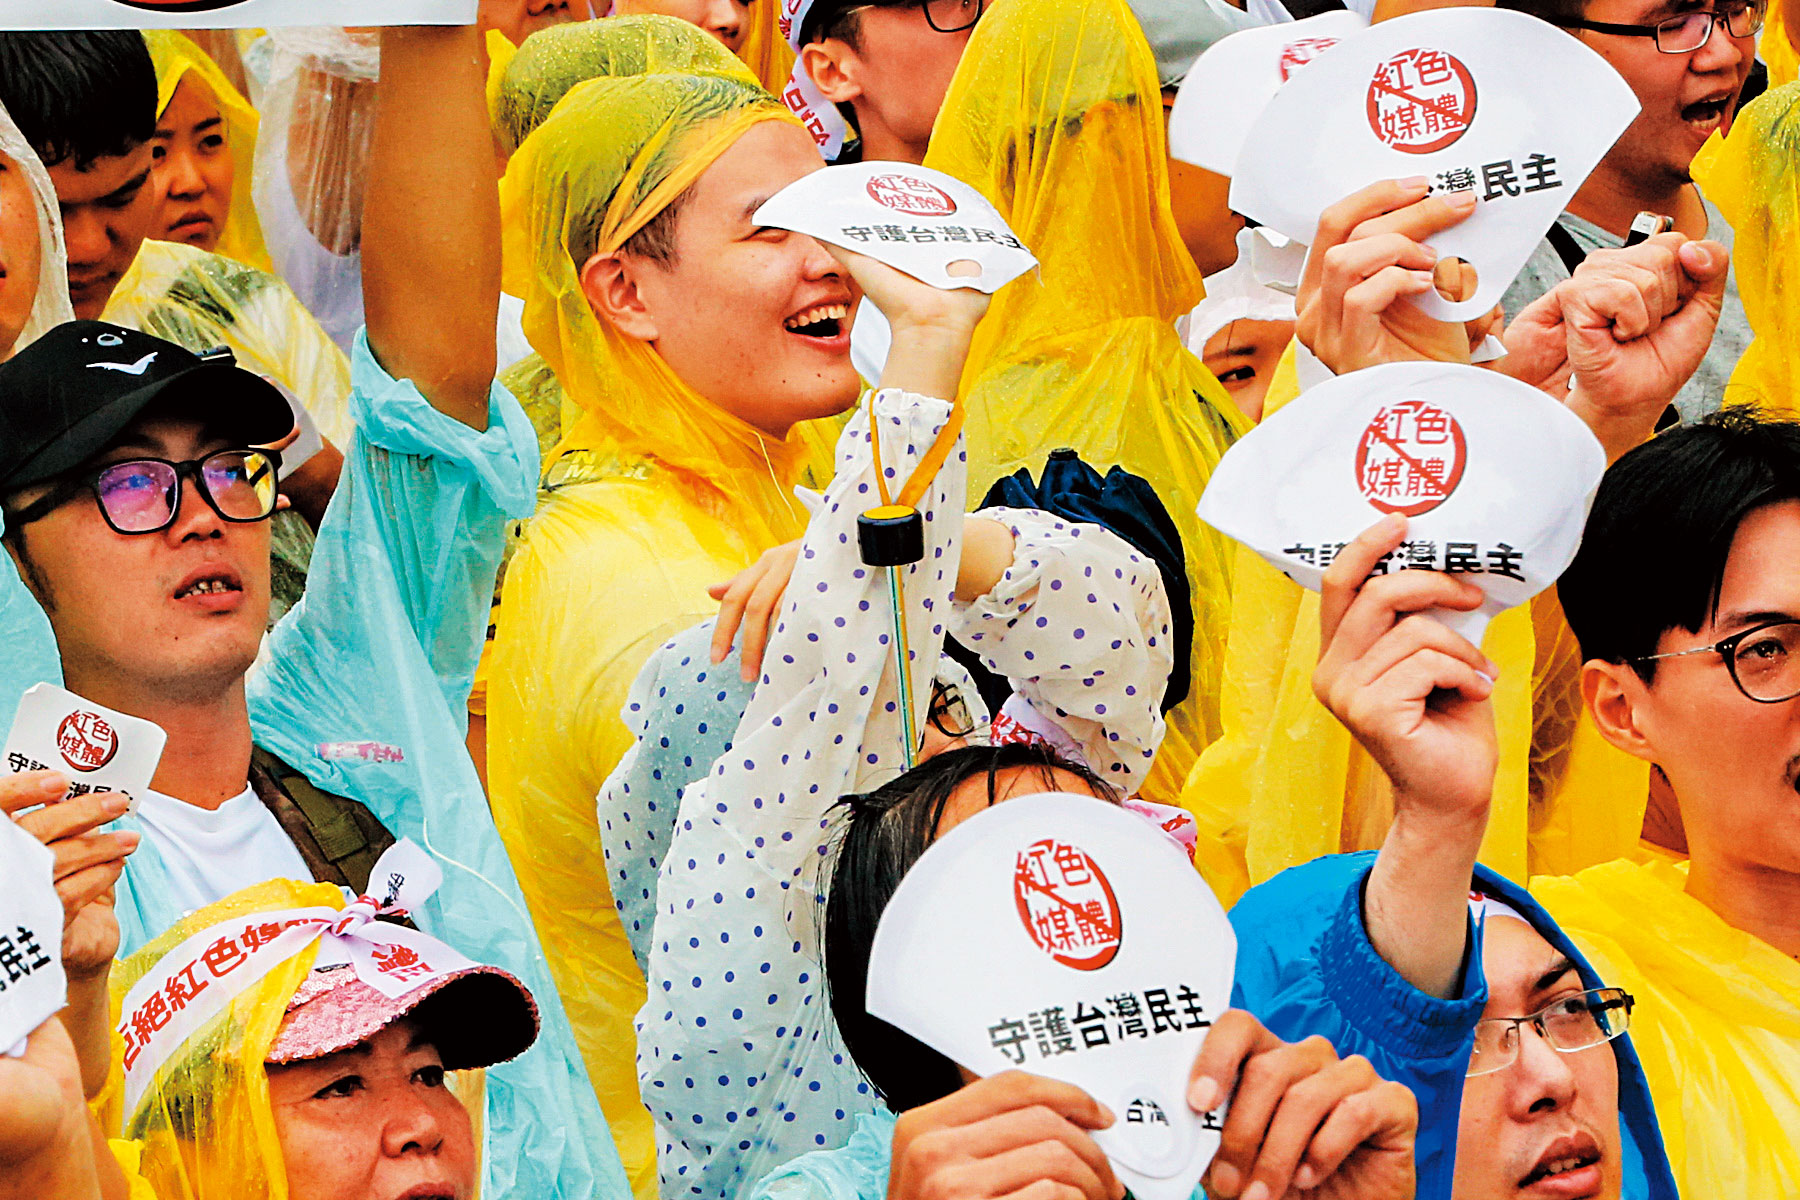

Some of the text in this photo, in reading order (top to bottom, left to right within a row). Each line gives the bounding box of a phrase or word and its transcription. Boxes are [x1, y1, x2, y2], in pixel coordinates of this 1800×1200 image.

[1372, 49, 1455, 95] 紅色
[1380, 91, 1466, 146] 媒體
[842, 224, 1026, 251] 守護台灣民主
[1367, 403, 1452, 447] 紅色
[1366, 457, 1448, 500] 媒體
[66, 711, 112, 741] 紅色
[59, 736, 110, 768] 媒體
[1017, 841, 1094, 892] 紅色
[1035, 899, 1115, 954] 媒體
[986, 983, 1213, 1067] 守護台灣民主
